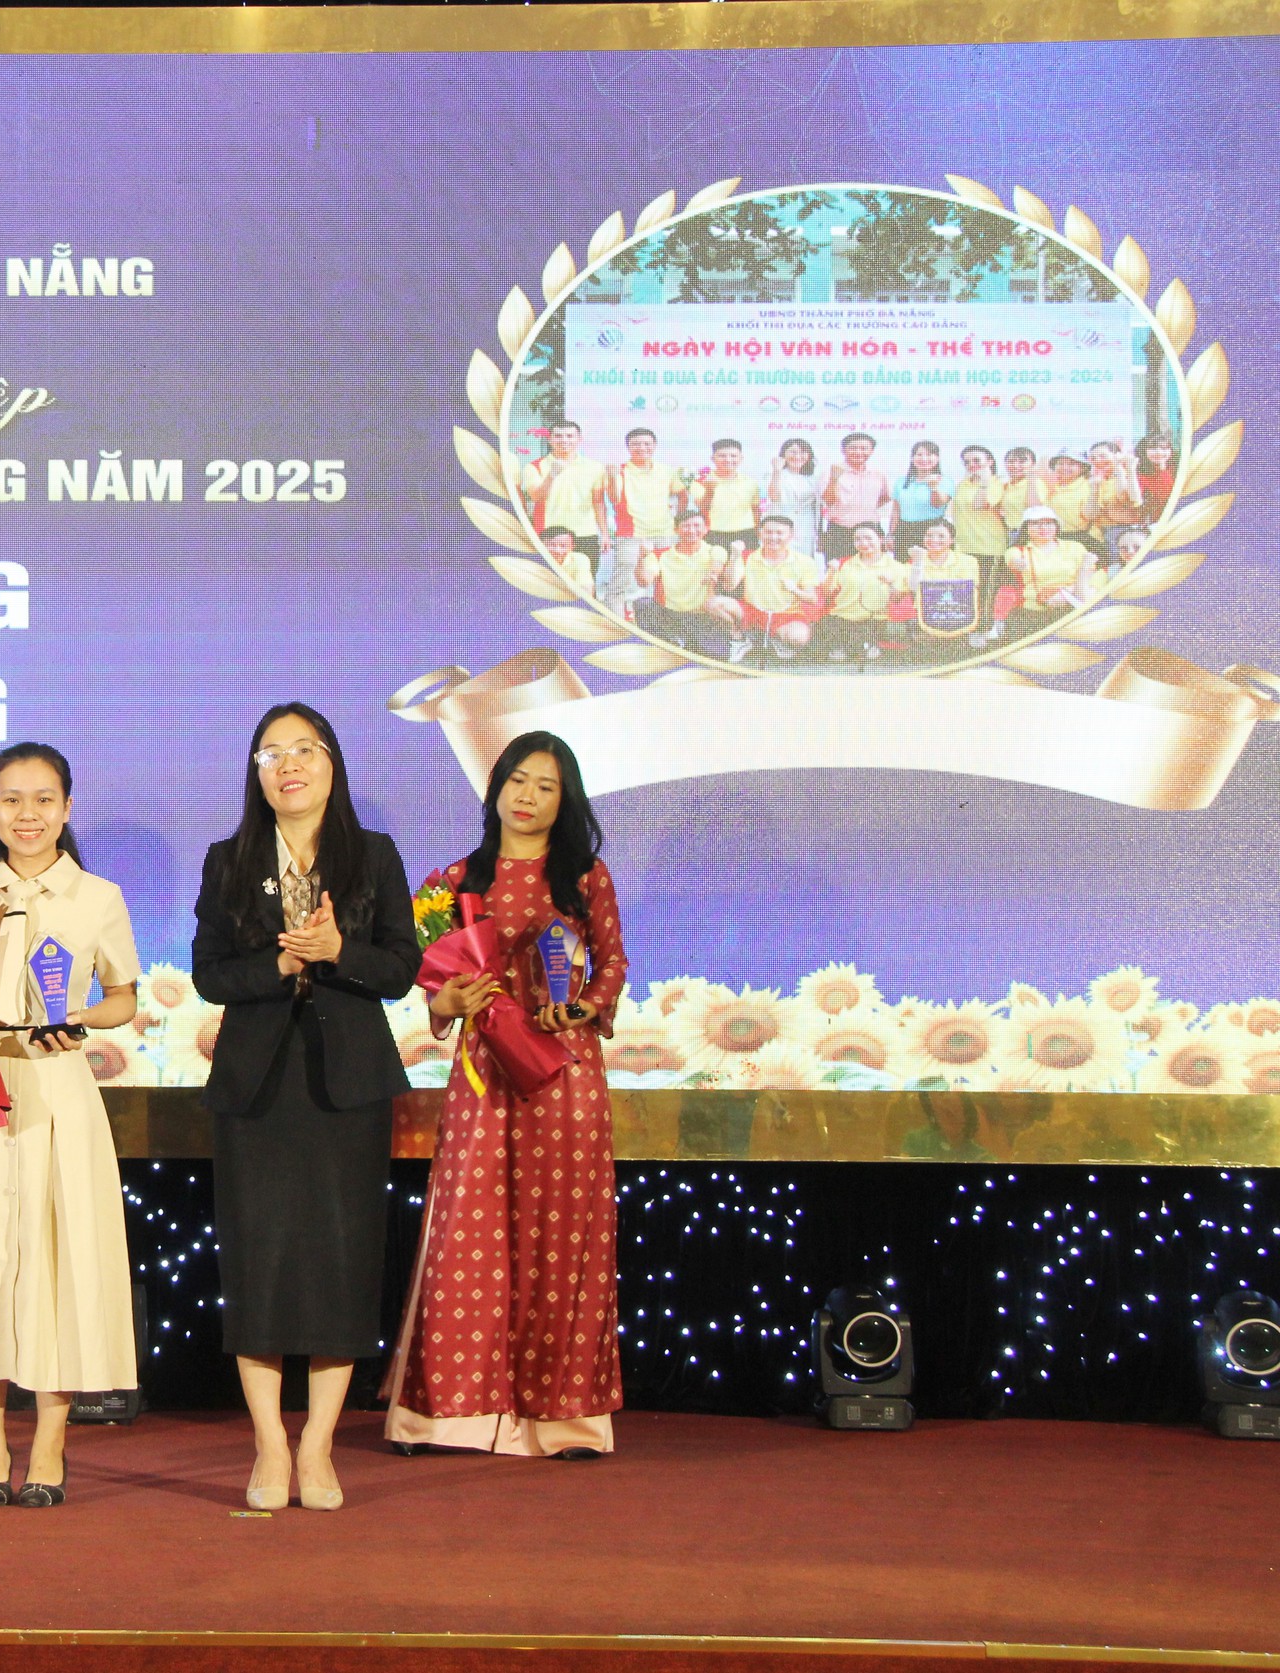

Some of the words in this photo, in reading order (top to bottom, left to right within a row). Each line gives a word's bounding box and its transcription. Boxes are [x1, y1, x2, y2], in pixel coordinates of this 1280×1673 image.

[7, 243, 154, 297] NẴNG
[800, 308, 844, 318] THÀNH
[902, 321, 928, 329] CAO
[643, 336, 715, 357] NGÀY
[725, 337, 771, 362] HỘI
[781, 338, 833, 357] VĂN
[841, 337, 898, 357] HÓA
[927, 333, 975, 356] THỂ
[982, 340, 1053, 356] THAO
[631, 370, 657, 385] THI
[663, 370, 697, 385] ĐUA
[703, 367, 739, 385] CÁC
[746, 367, 815, 385] TRƯỜNG
[822, 370, 856, 385] CAO
[966, 370, 1002, 387] HỌC
[1008, 370, 1052, 384] 2023
[1070, 370, 1113, 384] 2024
[48, 450, 183, 500] NĂM
[204, 458, 347, 500] 2025
